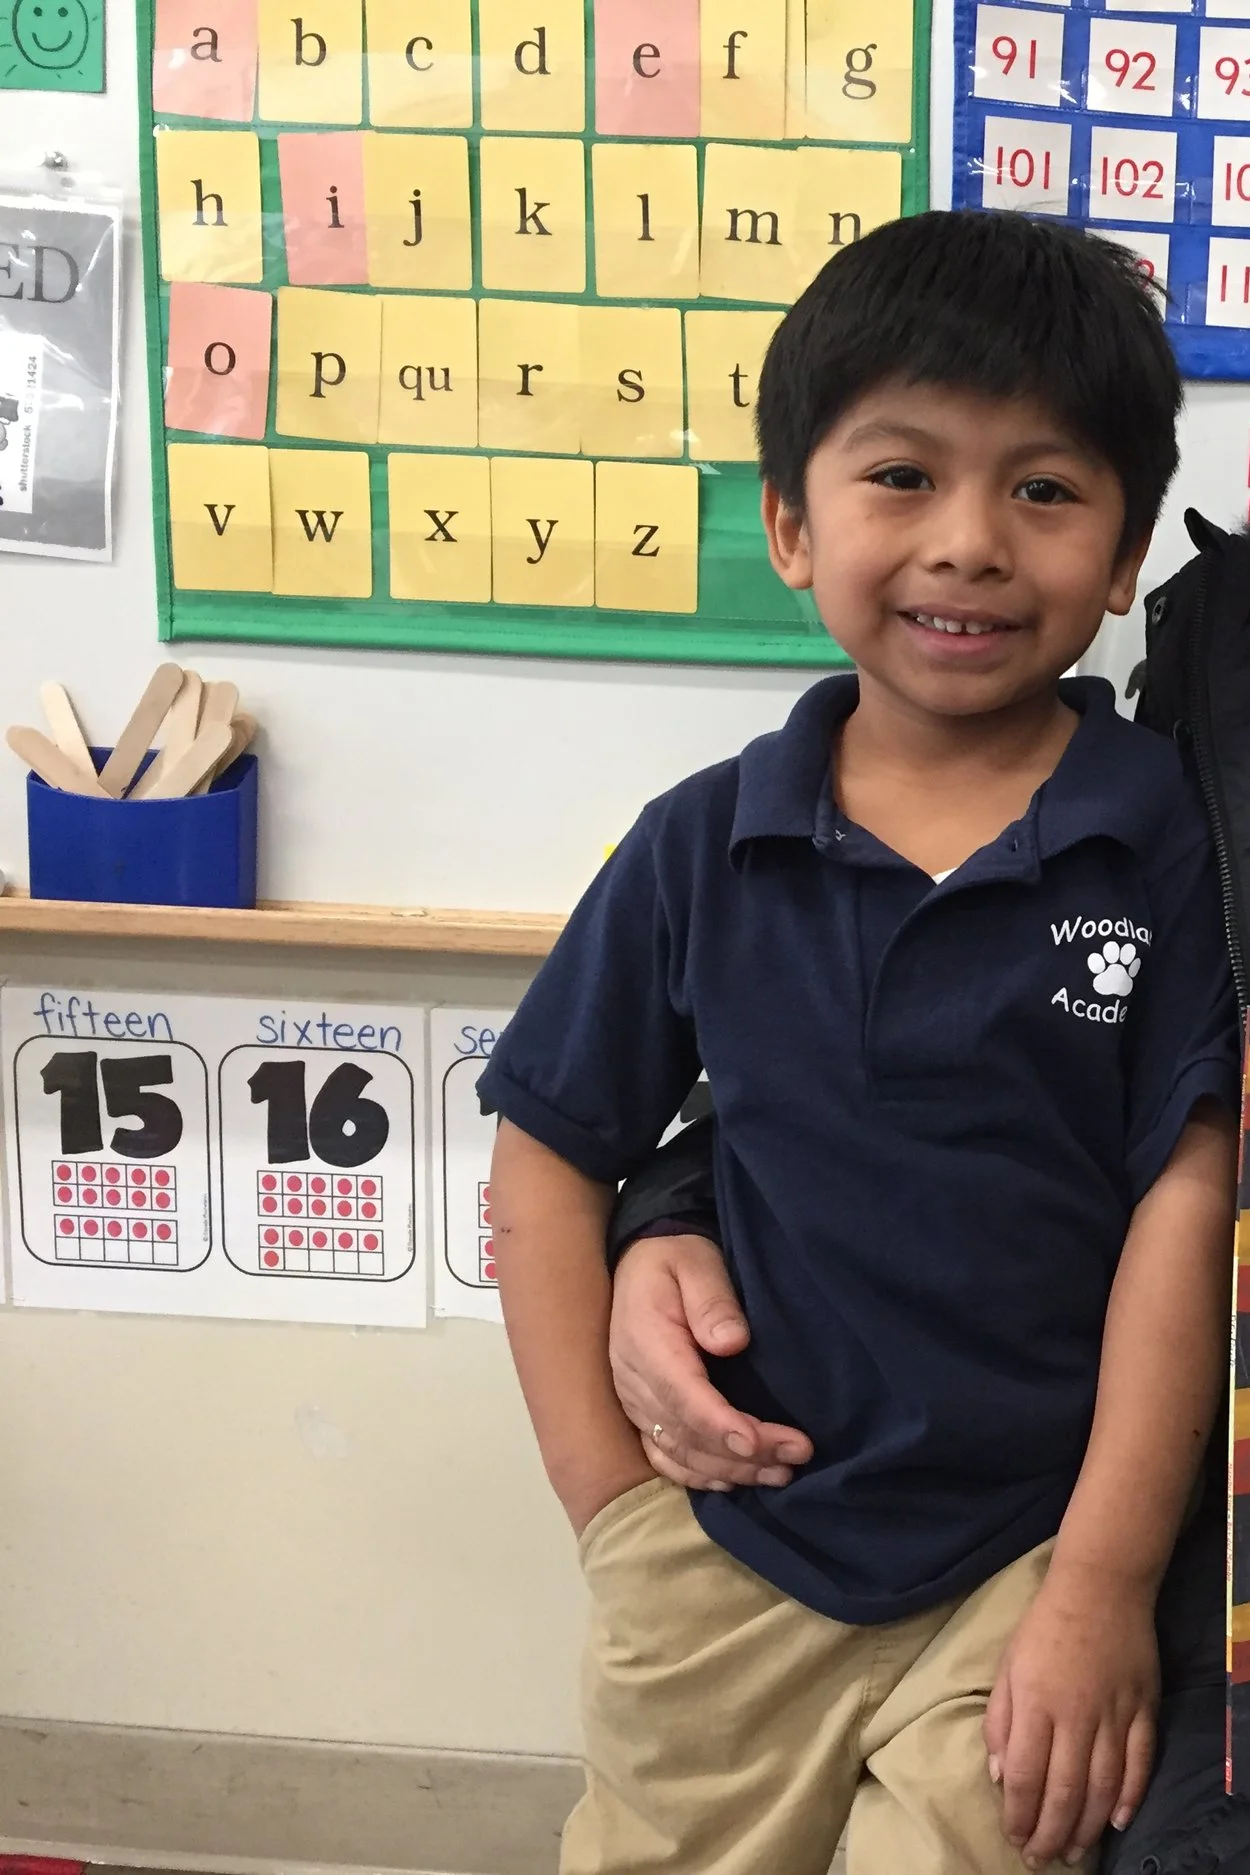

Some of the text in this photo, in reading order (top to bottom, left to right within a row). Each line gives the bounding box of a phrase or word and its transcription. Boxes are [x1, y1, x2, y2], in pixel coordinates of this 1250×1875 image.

[191, 17, 878, 100] a b c d e f g
[991, 35, 1037, 78] 91
[1104, 48, 1156, 91] 92
[995, 147, 1051, 189] 101
[1101, 156, 1164, 200] 102
[190, 178, 228, 227] h
[325, 185, 345, 229] i
[402, 188, 423, 247] j
[514, 187, 553, 236] k
[724, 208, 783, 246] m
[827, 212, 861, 245] n
[204, 341, 751, 408] o p qu r s t
[203, 503, 660, 565] v w x y z
[1050, 916, 1152, 947] Woodla
[34, 992, 174, 1041] fifteen
[257, 1013, 401, 1051] sixteen
[40, 1051, 183, 1159] 15
[247, 1060, 389, 1167] 16
